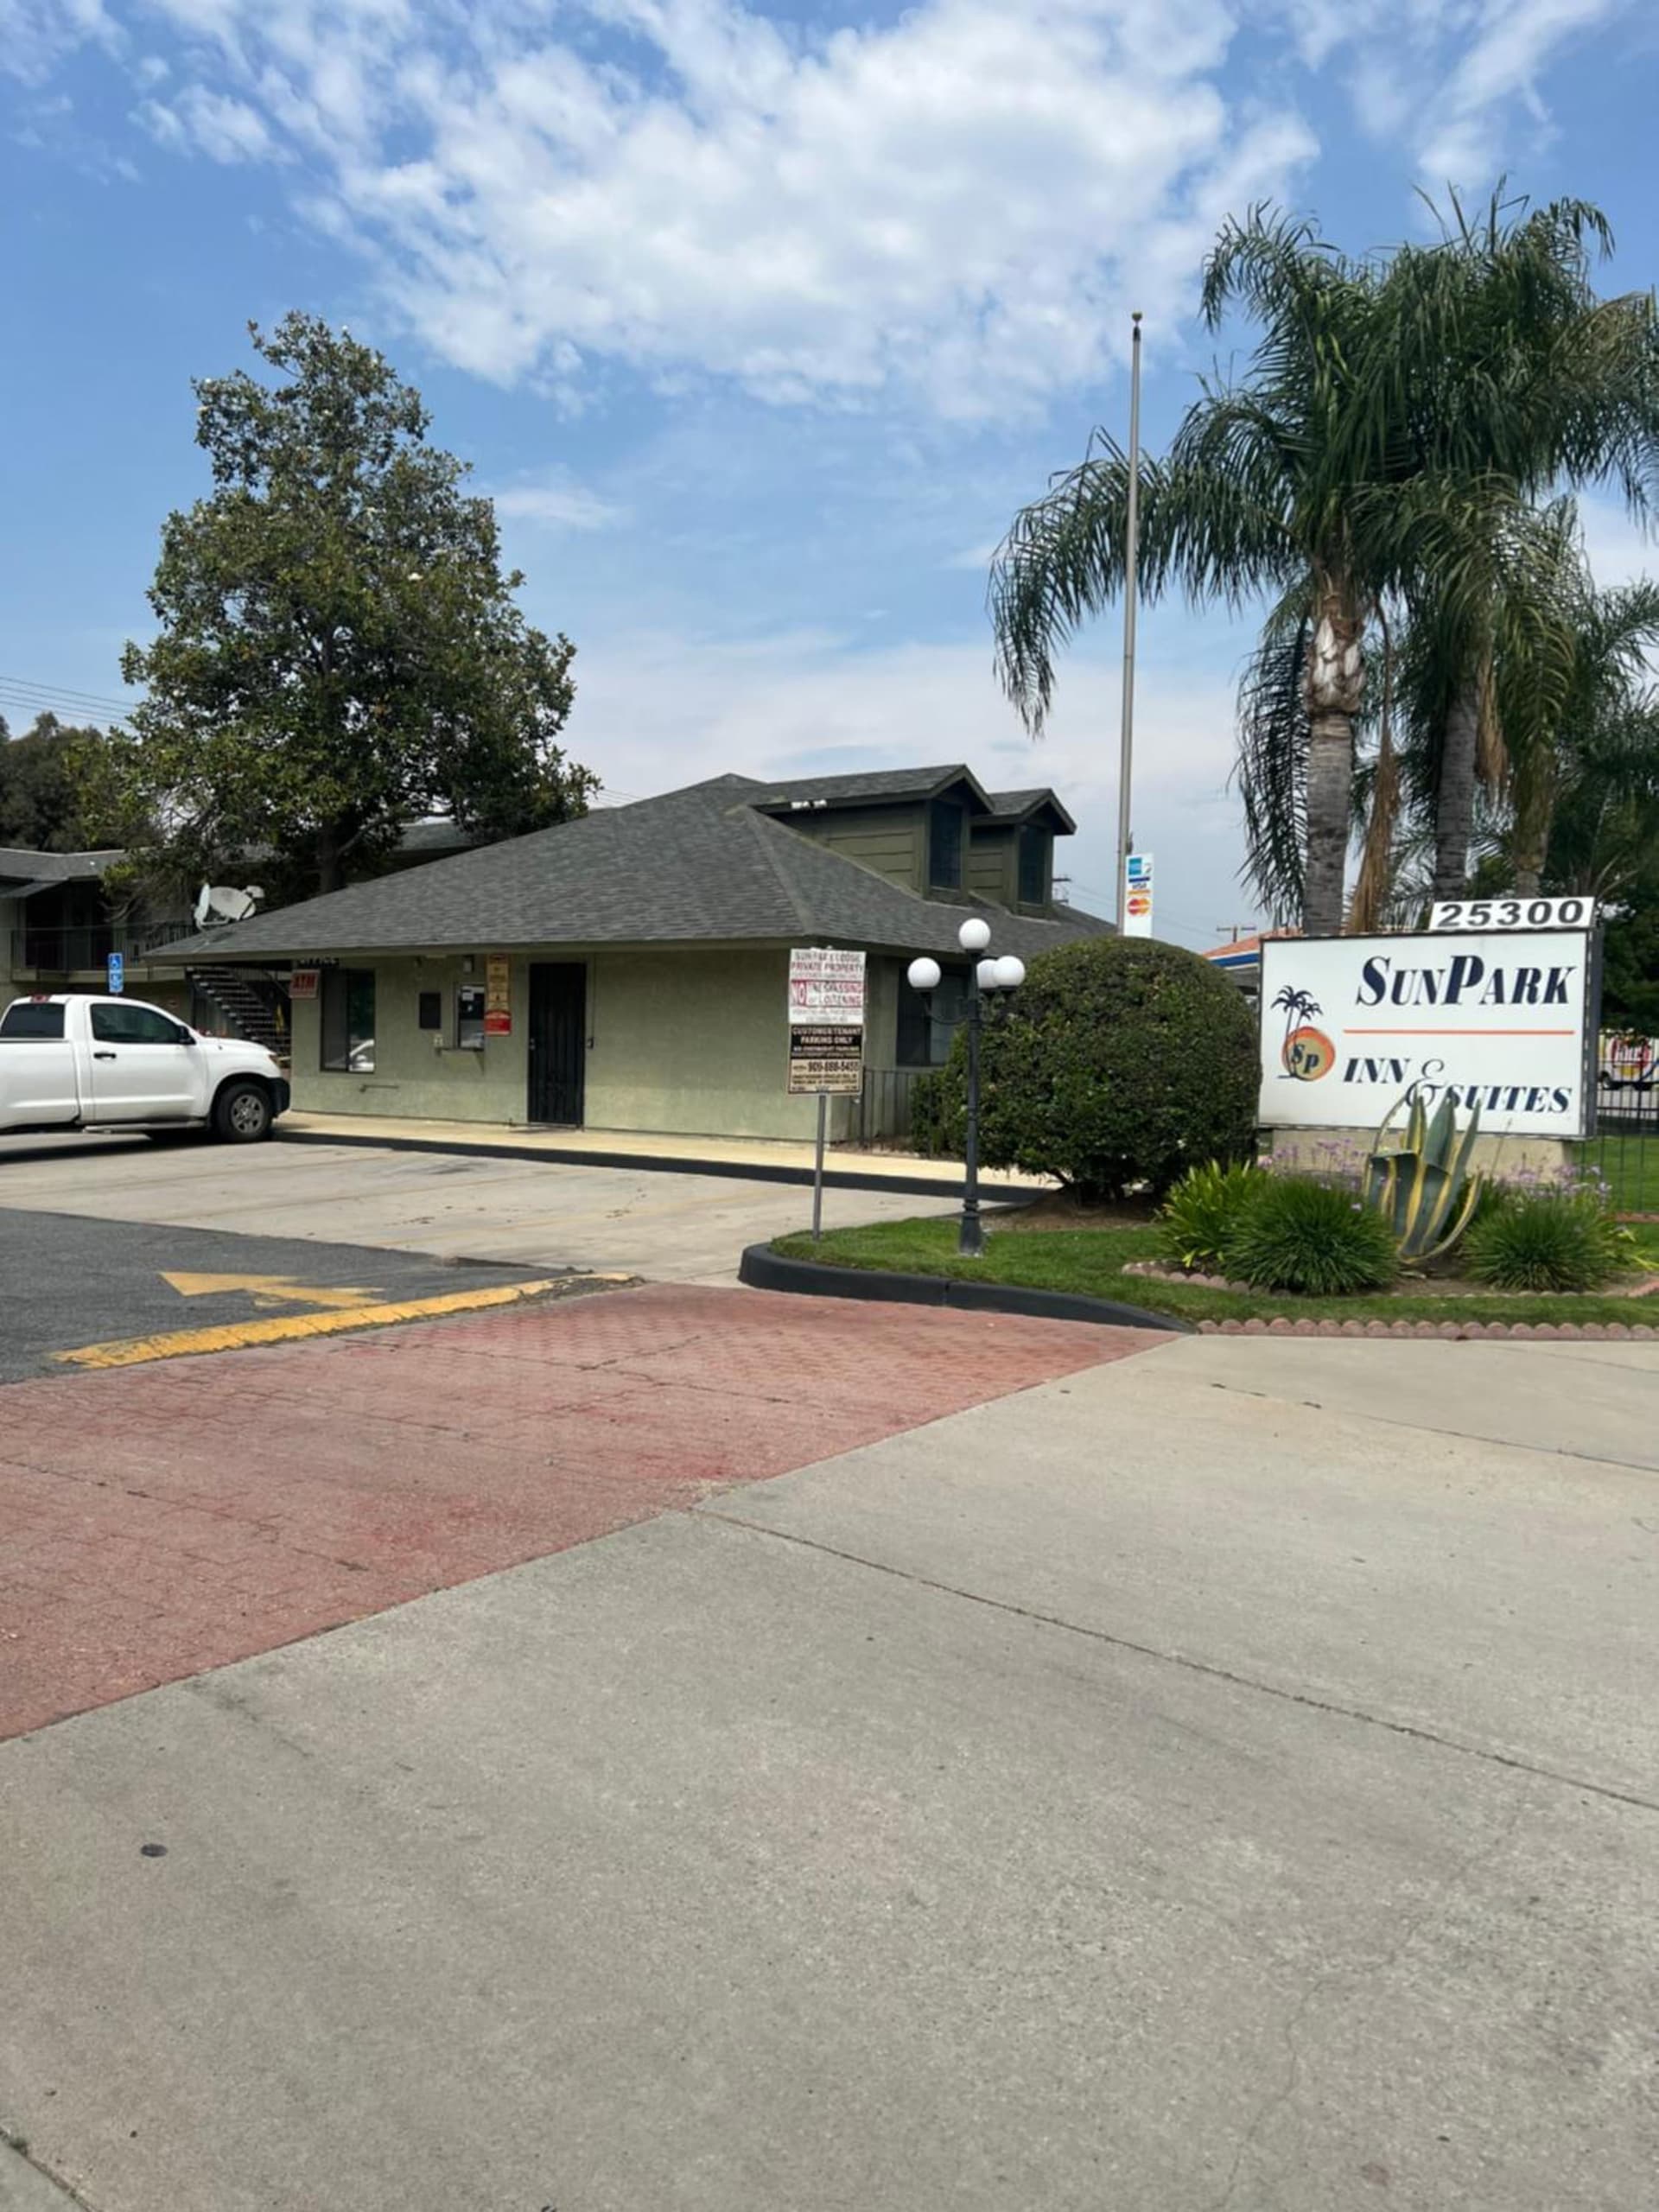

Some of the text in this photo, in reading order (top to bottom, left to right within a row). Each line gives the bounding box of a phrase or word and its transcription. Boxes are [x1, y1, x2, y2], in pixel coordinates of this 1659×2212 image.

[1437, 899, 1584, 928] 25300
[791, 962, 863, 974] PRIVATE PROPERTY
[293, 974, 316, 989] ATM
[801, 1036, 833, 1045] PARKING
[1344, 1057, 1410, 1084] INN
[1445, 1084, 1573, 1114] SUITES
